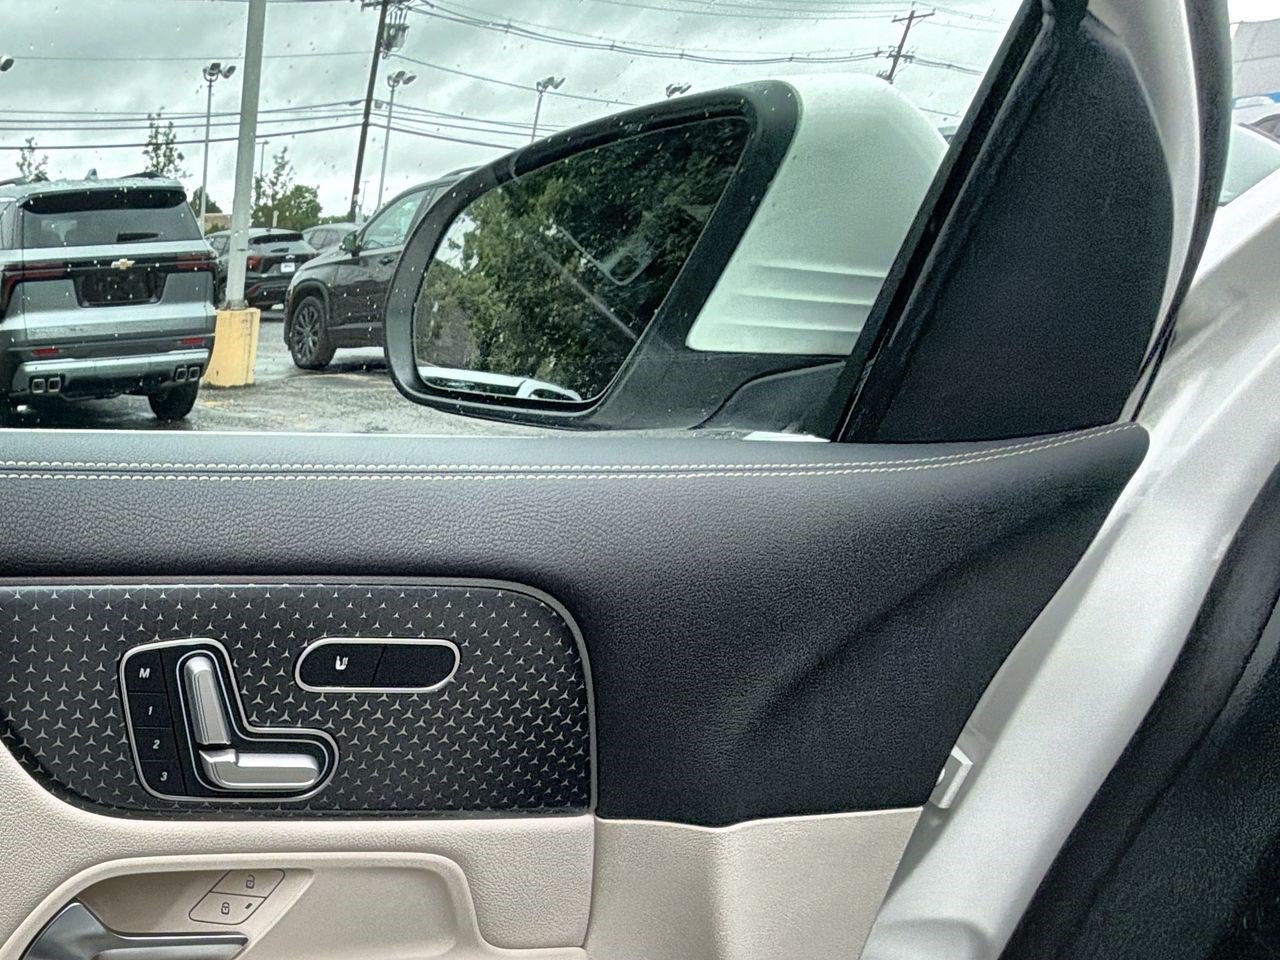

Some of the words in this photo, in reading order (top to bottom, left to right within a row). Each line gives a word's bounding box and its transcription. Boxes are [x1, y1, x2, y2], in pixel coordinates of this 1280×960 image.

[139, 668, 150, 678] M
[148, 706, 152, 715] 1
[152, 740, 160, 750] 2
[160, 772, 168, 781] 3
